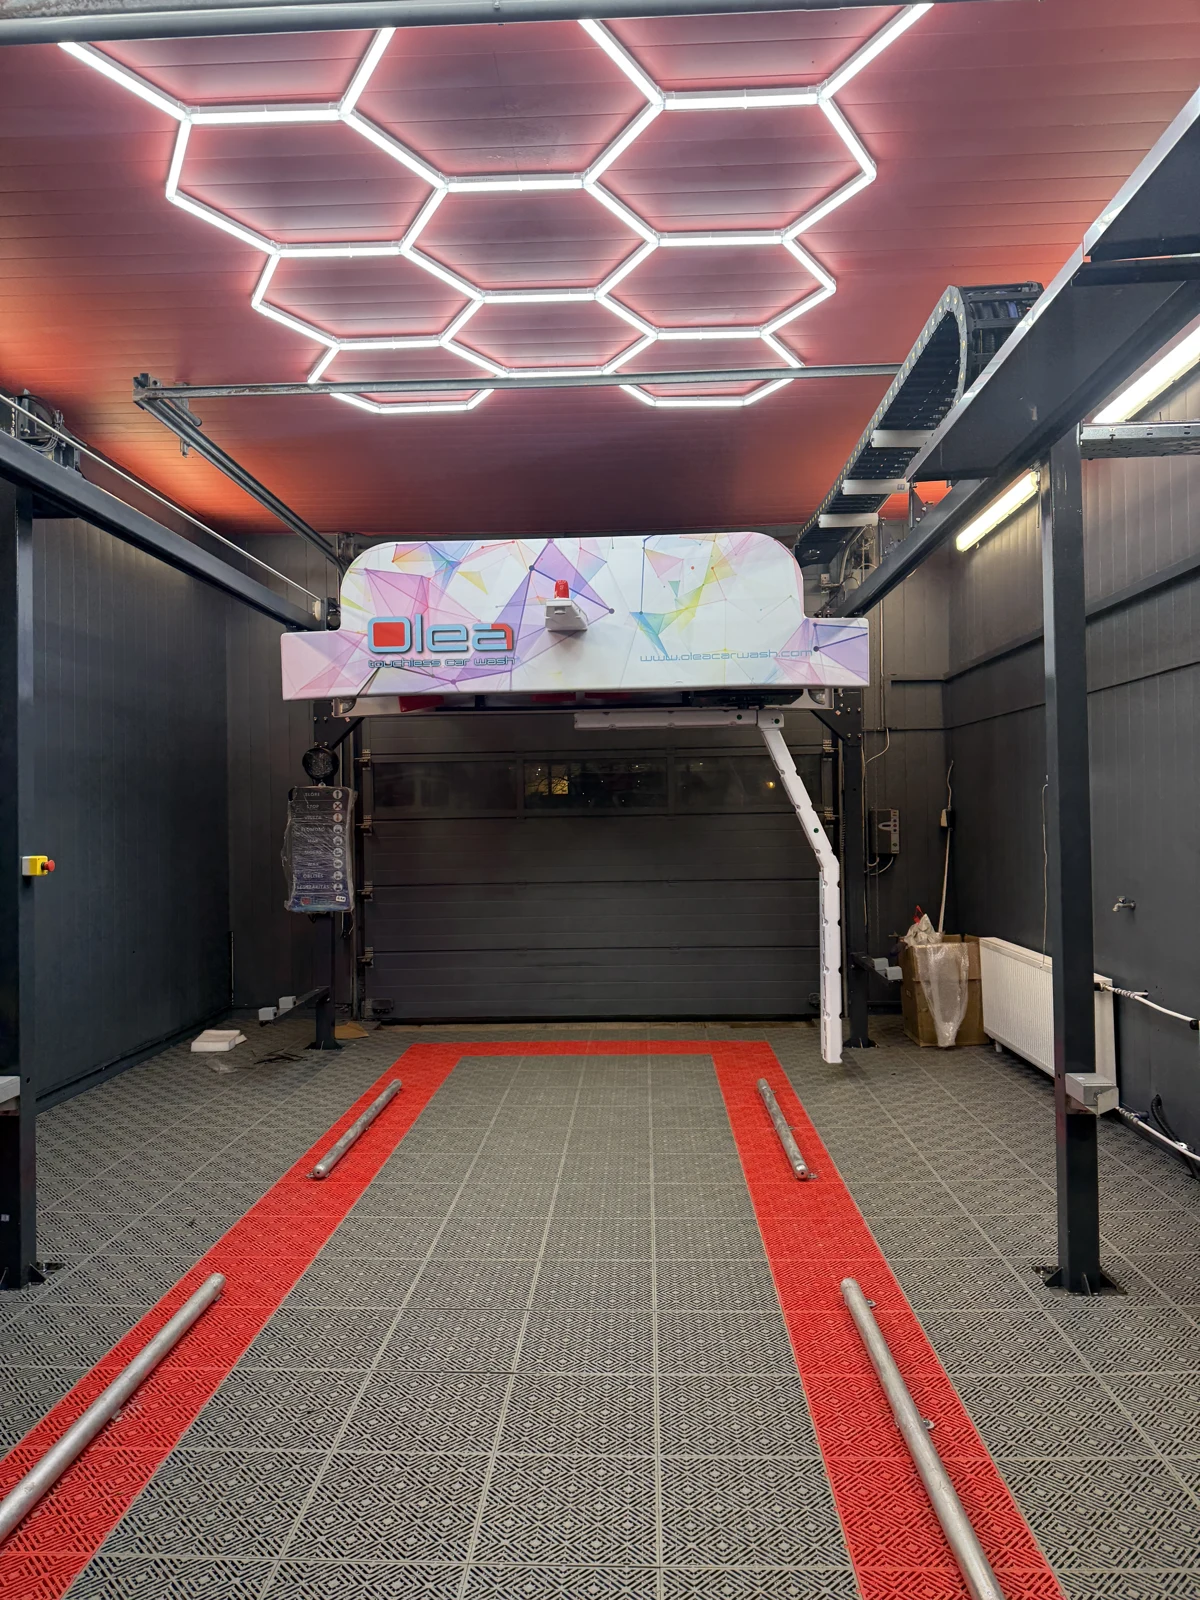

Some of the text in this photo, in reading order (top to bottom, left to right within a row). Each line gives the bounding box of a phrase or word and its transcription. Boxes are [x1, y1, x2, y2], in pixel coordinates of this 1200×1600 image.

[368, 613, 515, 654] Olea
[368, 655, 516, 668] touchless car wash
[640, 649, 813, 662] www.oleacarwash.com
